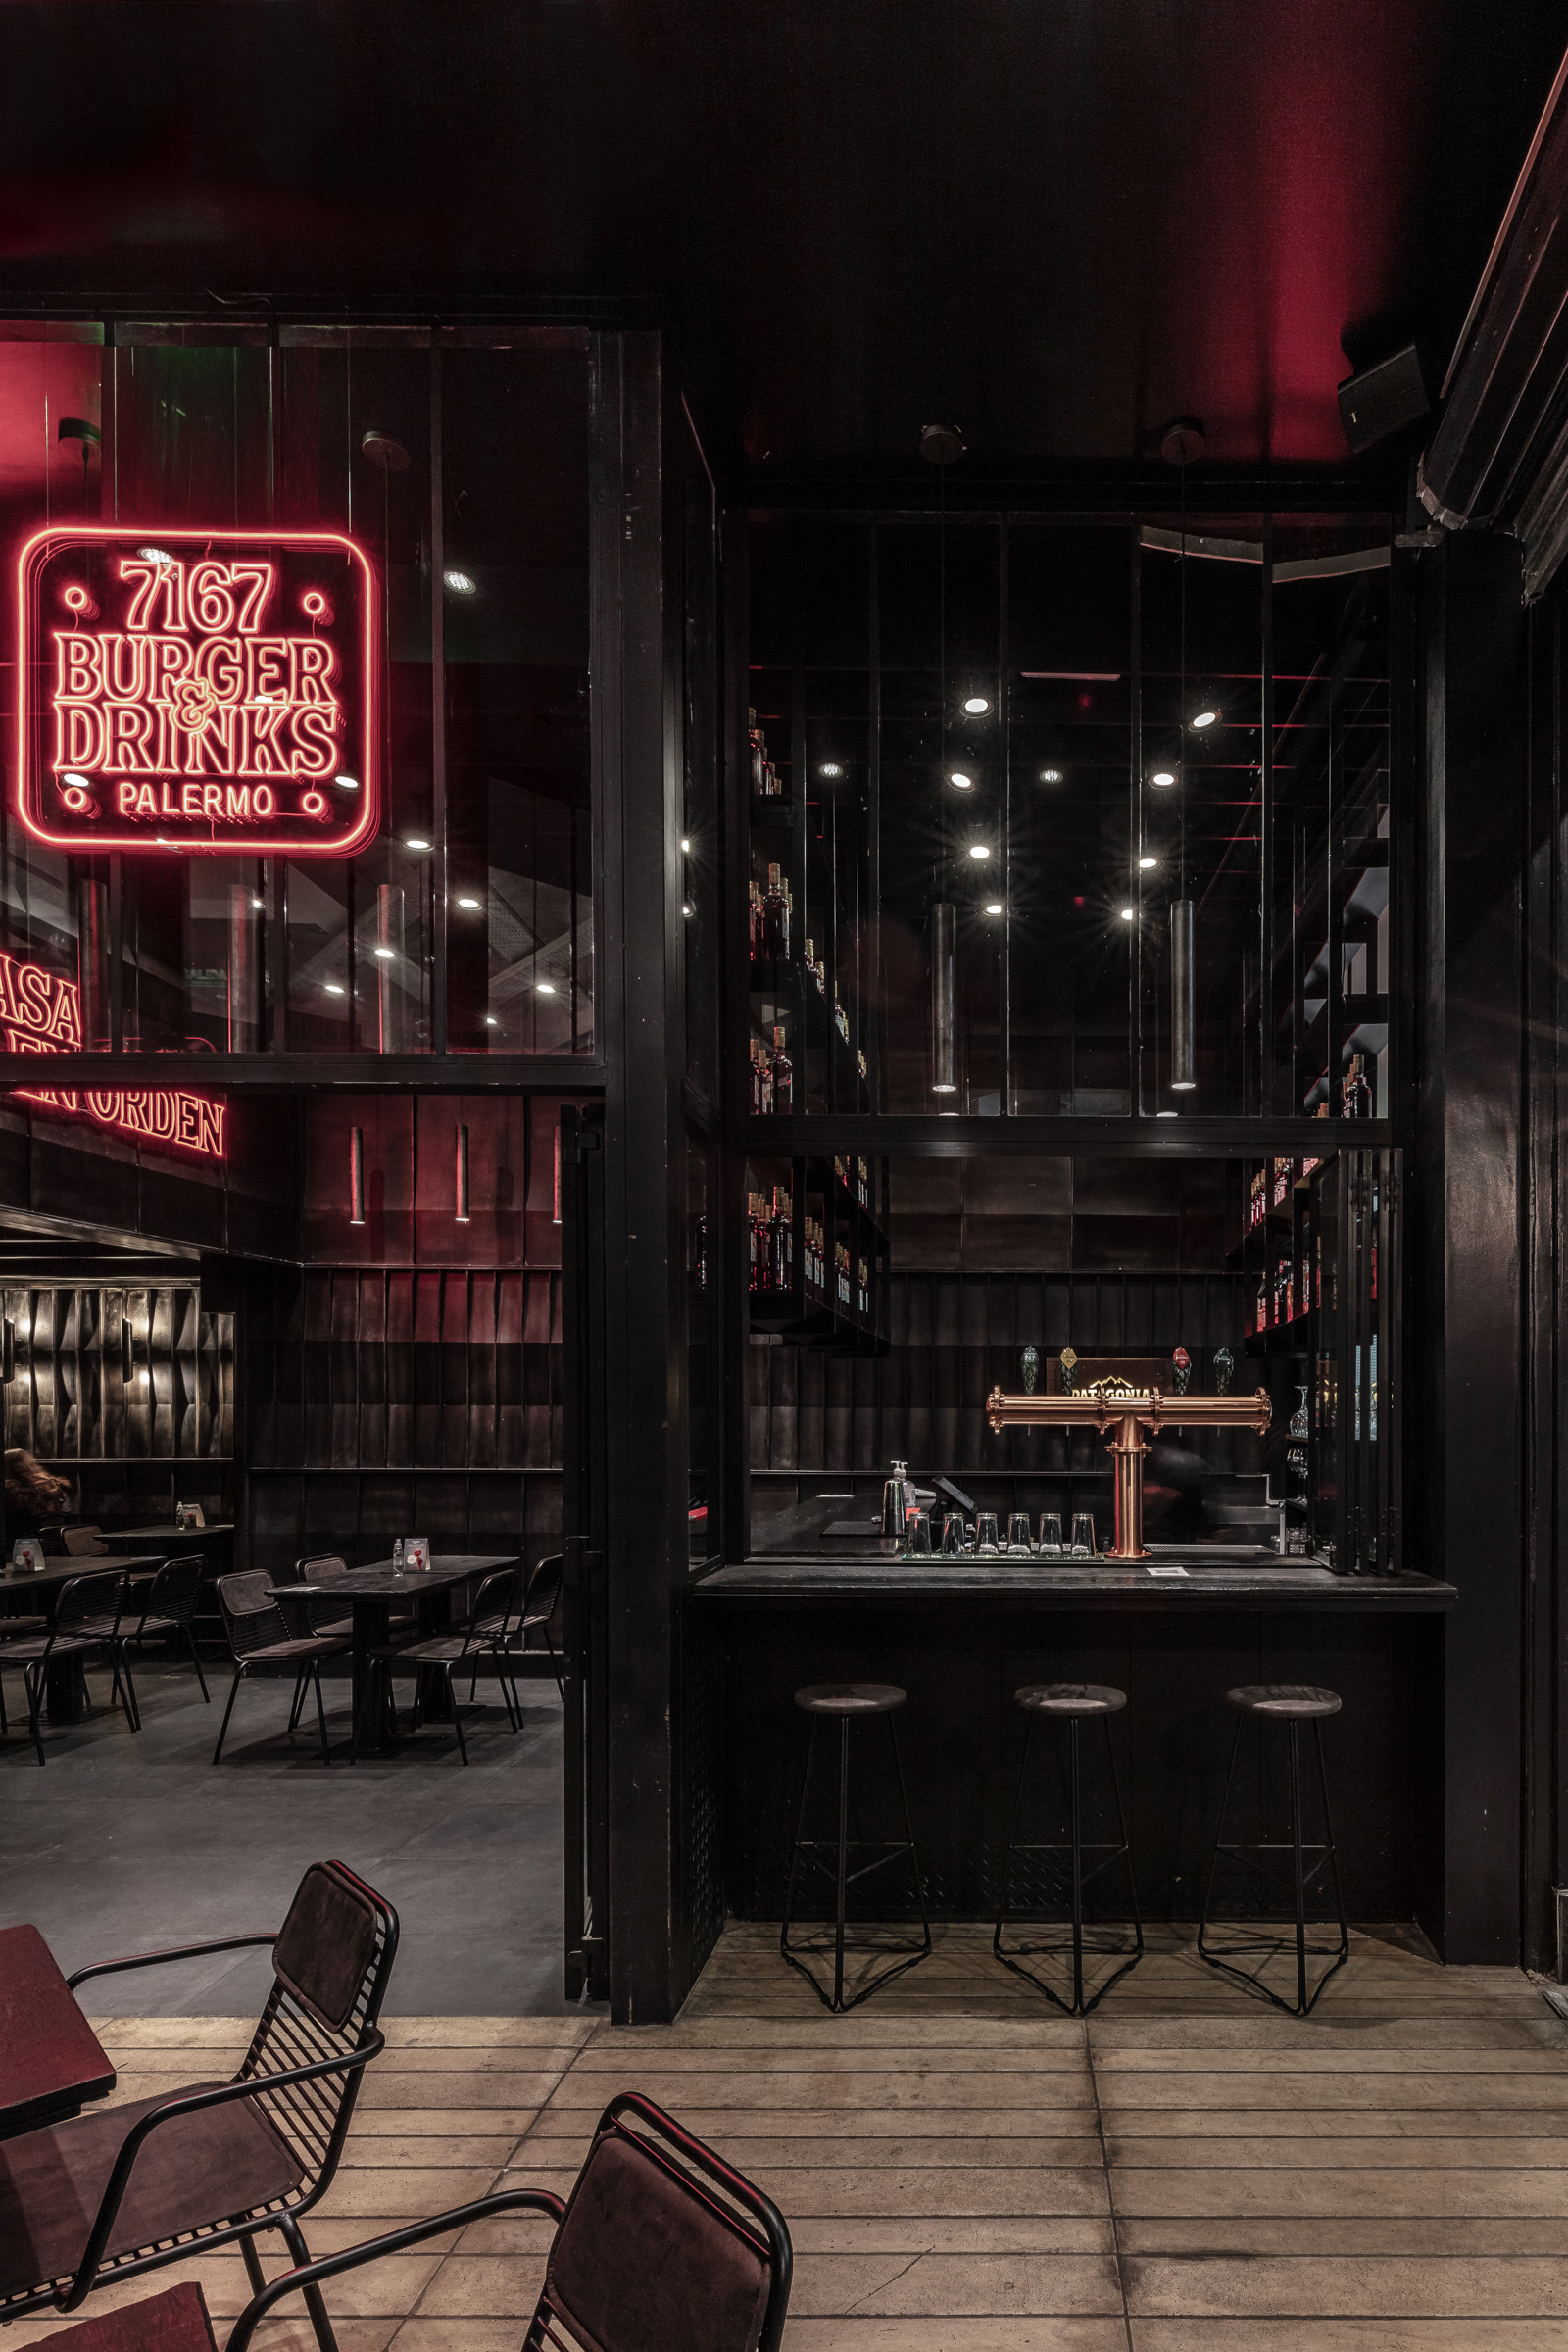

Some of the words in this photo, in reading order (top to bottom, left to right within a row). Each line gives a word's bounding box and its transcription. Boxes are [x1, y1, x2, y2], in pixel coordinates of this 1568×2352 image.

[120, 560, 273, 633] 7167
[53, 632, 338, 706] BURGER
[172, 677, 216, 734] &
[52, 701, 339, 776] DRINKS
[119, 782, 274, 816] PALERMO
[1071, 1388, 1151, 1398] PATGONIA
